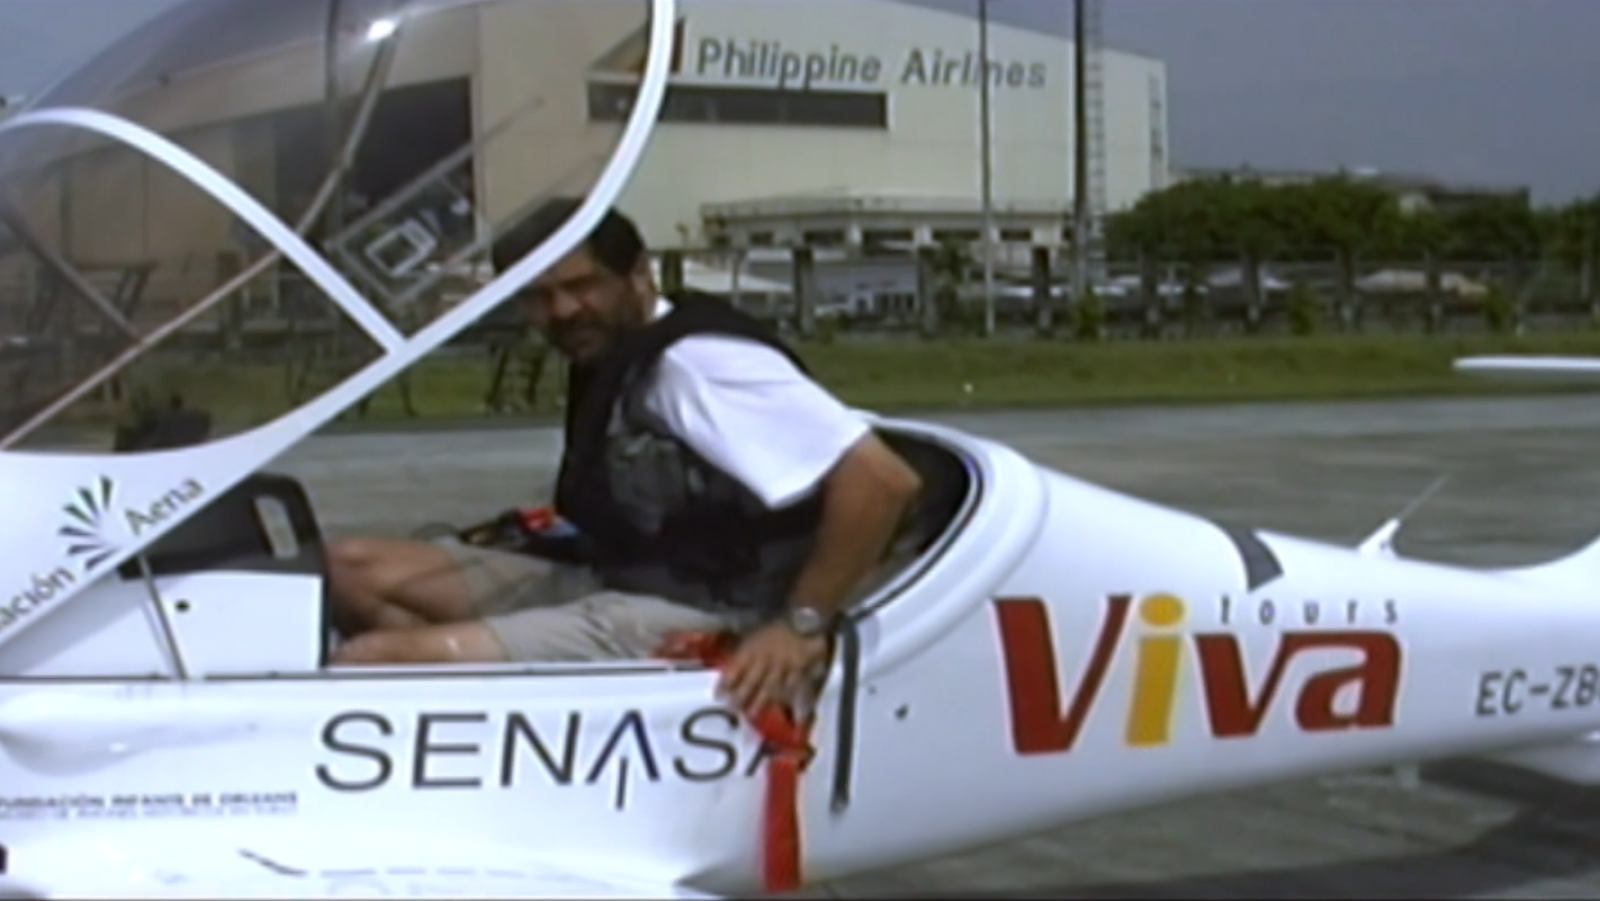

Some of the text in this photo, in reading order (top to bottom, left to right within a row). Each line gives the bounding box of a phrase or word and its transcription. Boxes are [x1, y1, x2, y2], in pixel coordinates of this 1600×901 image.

[698, 38, 881, 91] Philippine
[125, 478, 204, 537] Aena
[994, 594, 1402, 756] Viva
[1476, 665, 1600, 717] EC-ZB
